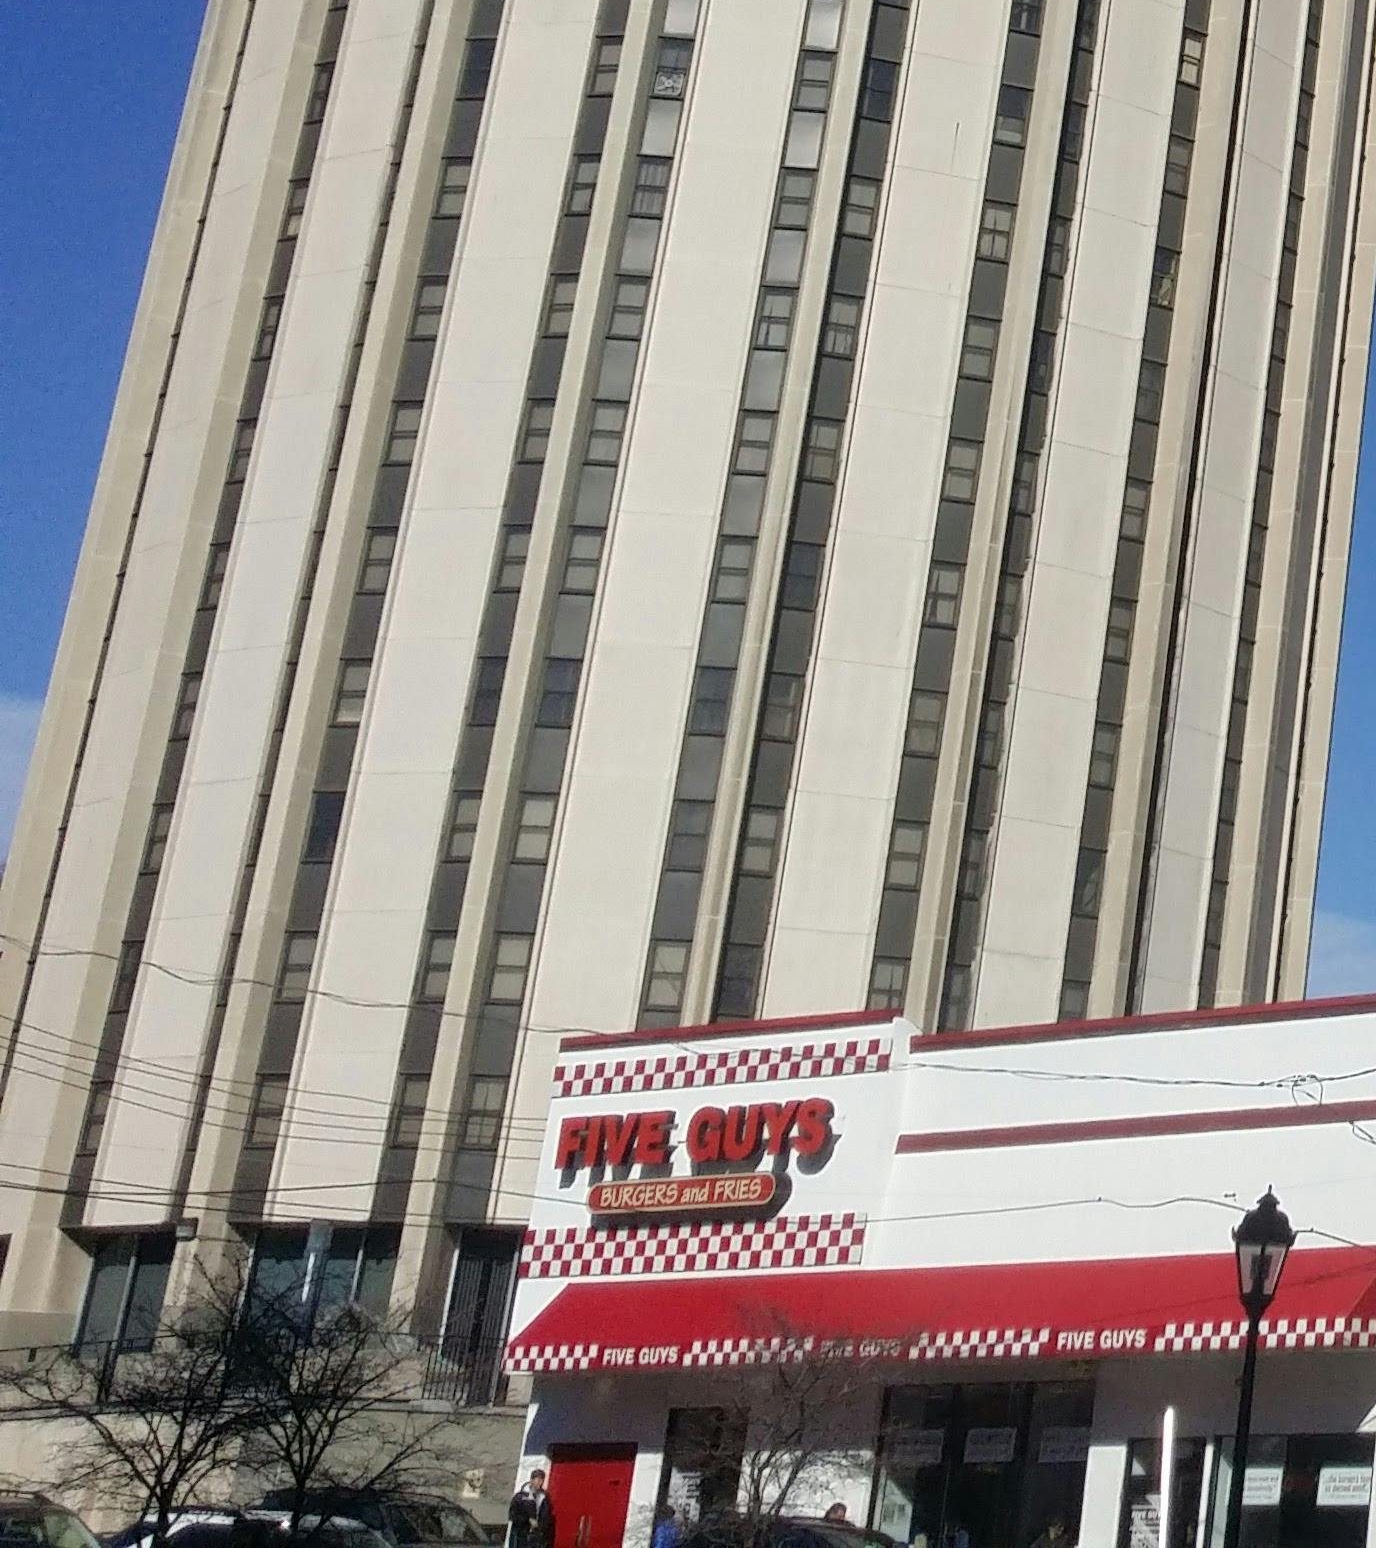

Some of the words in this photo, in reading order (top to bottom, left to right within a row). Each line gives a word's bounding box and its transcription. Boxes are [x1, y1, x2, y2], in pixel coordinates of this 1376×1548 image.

[555, 1110, 676, 1170] FIVE
[686, 1097, 836, 1162] GUYS
[600, 1182, 678, 1208] BURGERS
[680, 1184, 709, 1204] and
[713, 1178, 762, 1203] FRIES
[859, 1337, 902, 1357] GUYS
[1057, 1329, 1095, 1351] FIVE
[1100, 1327, 1147, 1349] GUYS
[602, 1347, 636, 1366] FIVE
[638, 1344, 680, 1365] GUYS
